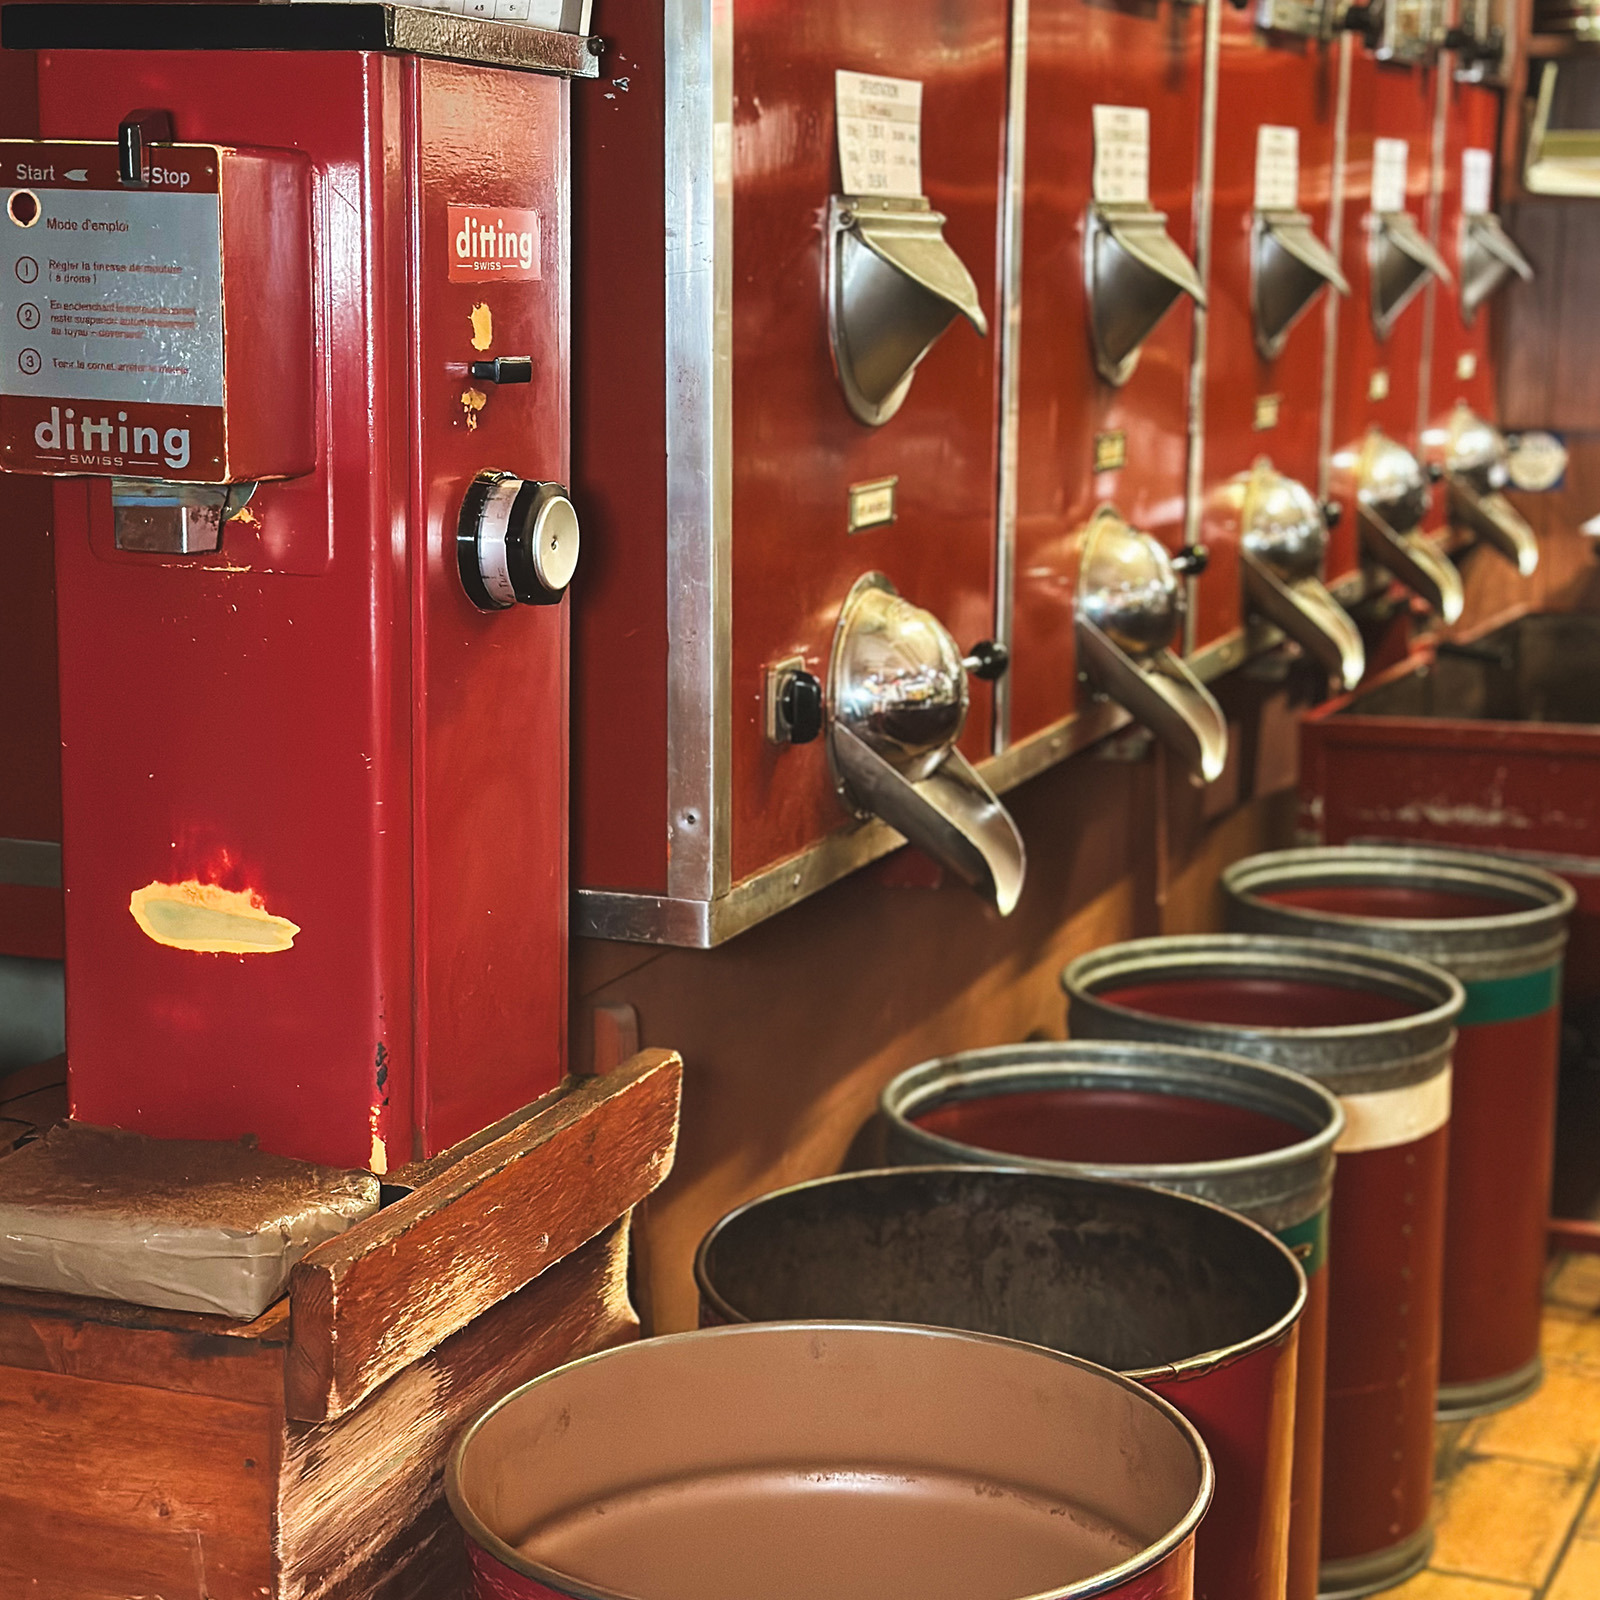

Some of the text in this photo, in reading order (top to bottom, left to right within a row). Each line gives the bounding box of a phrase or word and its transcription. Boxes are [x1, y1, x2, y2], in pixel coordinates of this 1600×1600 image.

[16, 163, 55, 182] Start
[151, 166, 191, 188] Stop
[46, 217, 129, 234] Mode d'emploi
[456, 216, 532, 270] ditting
[473, 261, 502, 271] SWISS
[34, 406, 190, 469] ditting
[69, 454, 124, 467] SWISS
